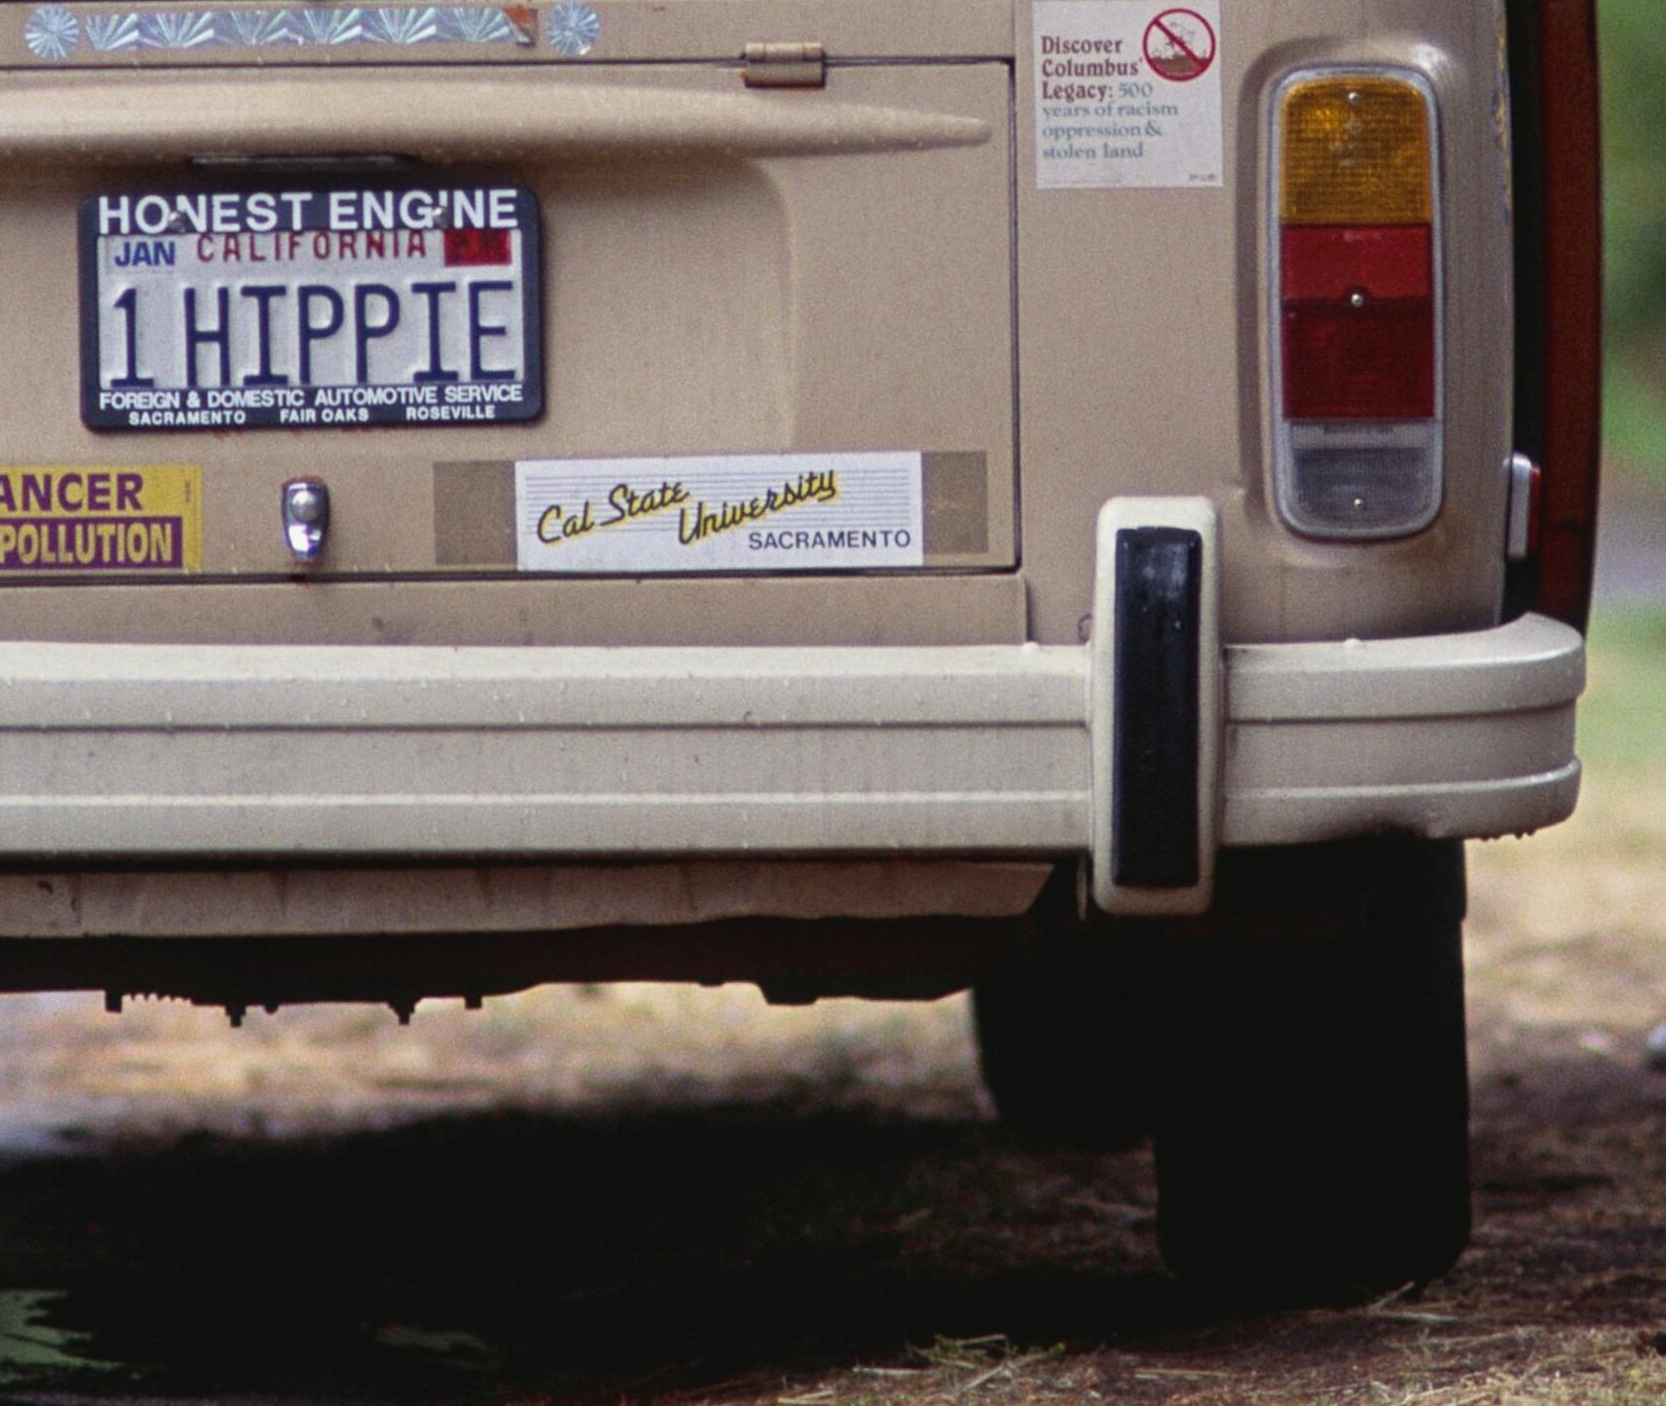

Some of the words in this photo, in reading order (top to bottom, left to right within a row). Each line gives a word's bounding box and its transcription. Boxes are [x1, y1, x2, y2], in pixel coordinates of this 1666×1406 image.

[1041, 36, 1122, 54] Discover
[1042, 81, 1113, 103] Legacy:
[1119, 83, 1153, 98] 500
[1042, 105, 1090, 117] years
[1094, 101, 1113, 116] of
[1118, 102, 1178, 116] racism
[1042, 121, 1141, 140] oppression
[1145, 121, 1163, 137] &
[1042, 143, 1096, 159] stolen
[1103, 142, 1144, 158] land
[99, 193, 312, 235] HONEST
[115, 242, 175, 267] JAN
[197, 231, 427, 263] CALIFORNIA
[100, 391, 180, 410] FOREIGN
[187, 391, 200, 409] &
[207, 389, 304, 408] DOMESTIC
[314, 387, 437, 406] AUTOMOTIVE
[444, 384, 523, 403] SERVICE
[128, 409, 246, 426] SACRAMENTO
[279, 407, 318, 423] FAIR
[321, 406, 370, 423] OAKS
[405, 404, 495, 421] ROSEVILLE
[537, 502, 596, 544] Cal
[600, 481, 691, 527] State
[677, 469, 838, 546] University
[748, 529, 912, 550] SACRAMENTO
